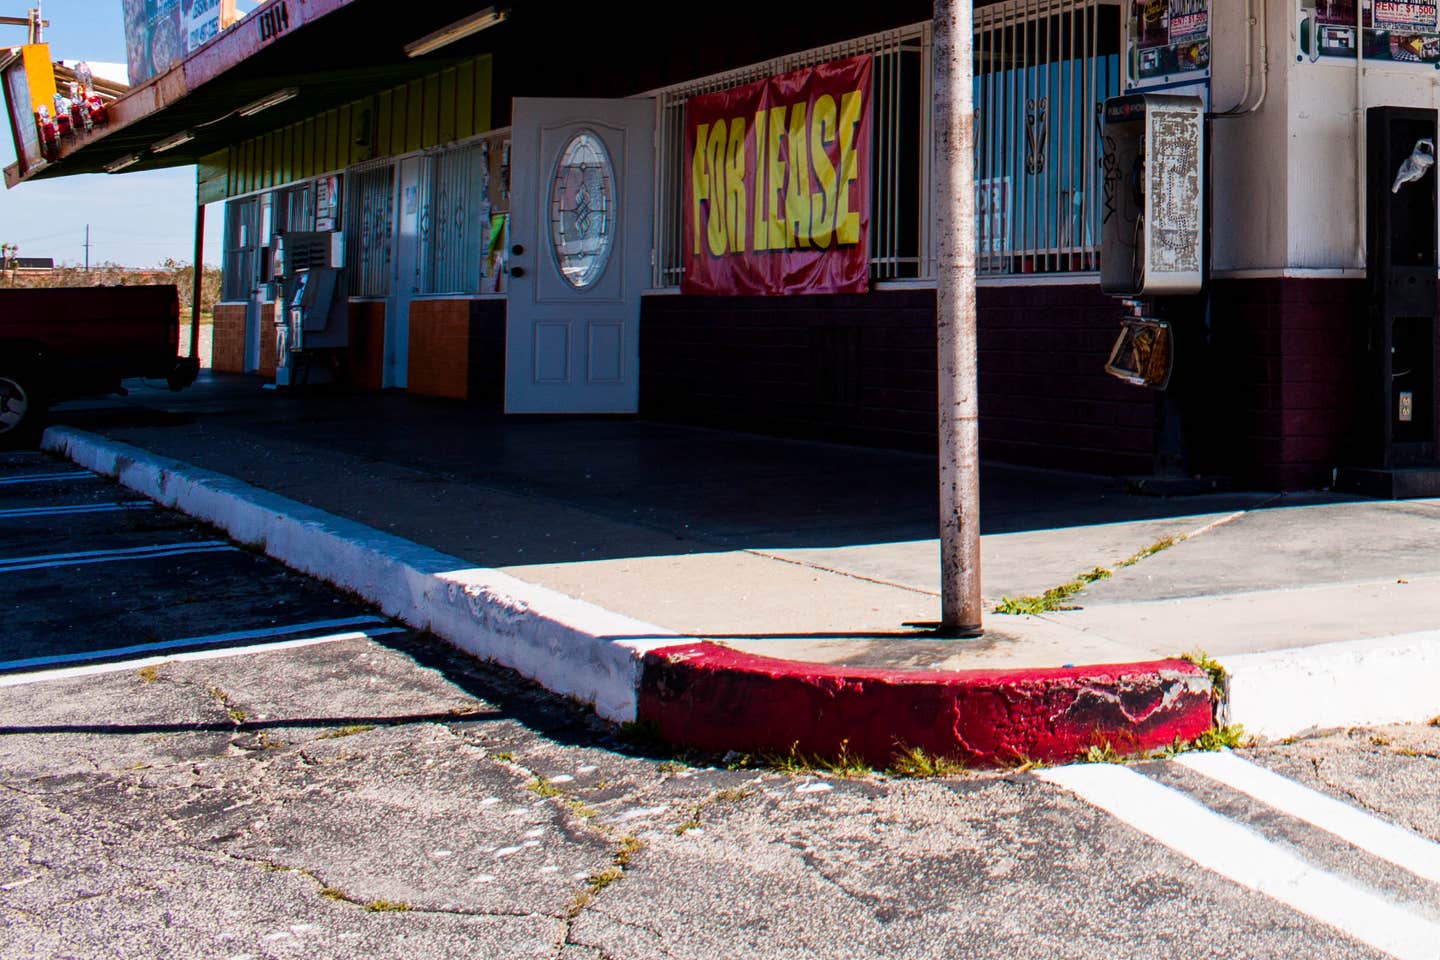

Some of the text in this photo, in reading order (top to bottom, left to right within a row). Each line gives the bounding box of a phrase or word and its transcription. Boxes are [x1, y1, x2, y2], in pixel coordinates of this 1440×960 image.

[1375, 2, 1404, 13] RENT:
[692, 117, 746, 257] FOR
[753, 89, 863, 251] LEASE
